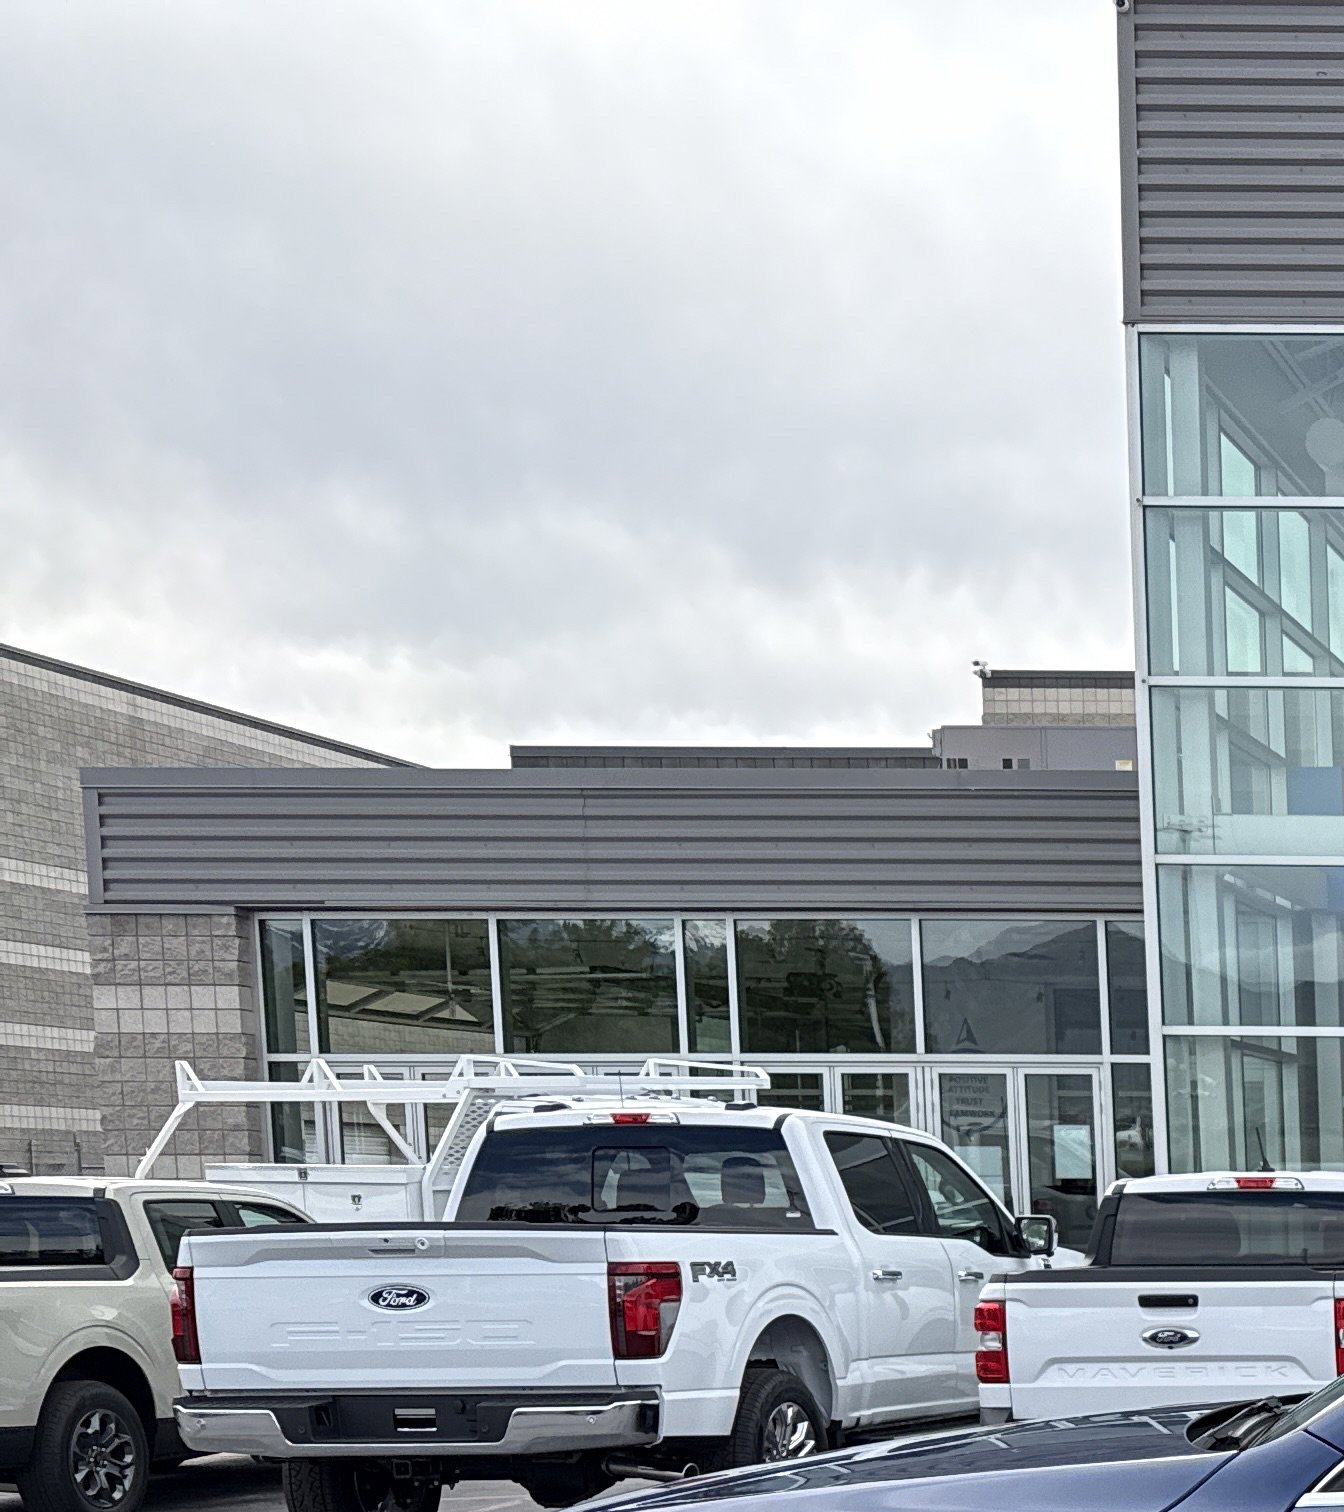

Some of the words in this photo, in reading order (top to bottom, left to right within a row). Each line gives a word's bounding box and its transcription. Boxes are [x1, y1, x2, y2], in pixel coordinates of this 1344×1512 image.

[956, 1097, 983, 1105] TRUST
[690, 1261, 737, 1282] FX4
[377, 1288, 418, 1309] Ford
[269, 1319, 535, 1348] F-150
[1057, 1365, 1290, 1381] MAVERICK
